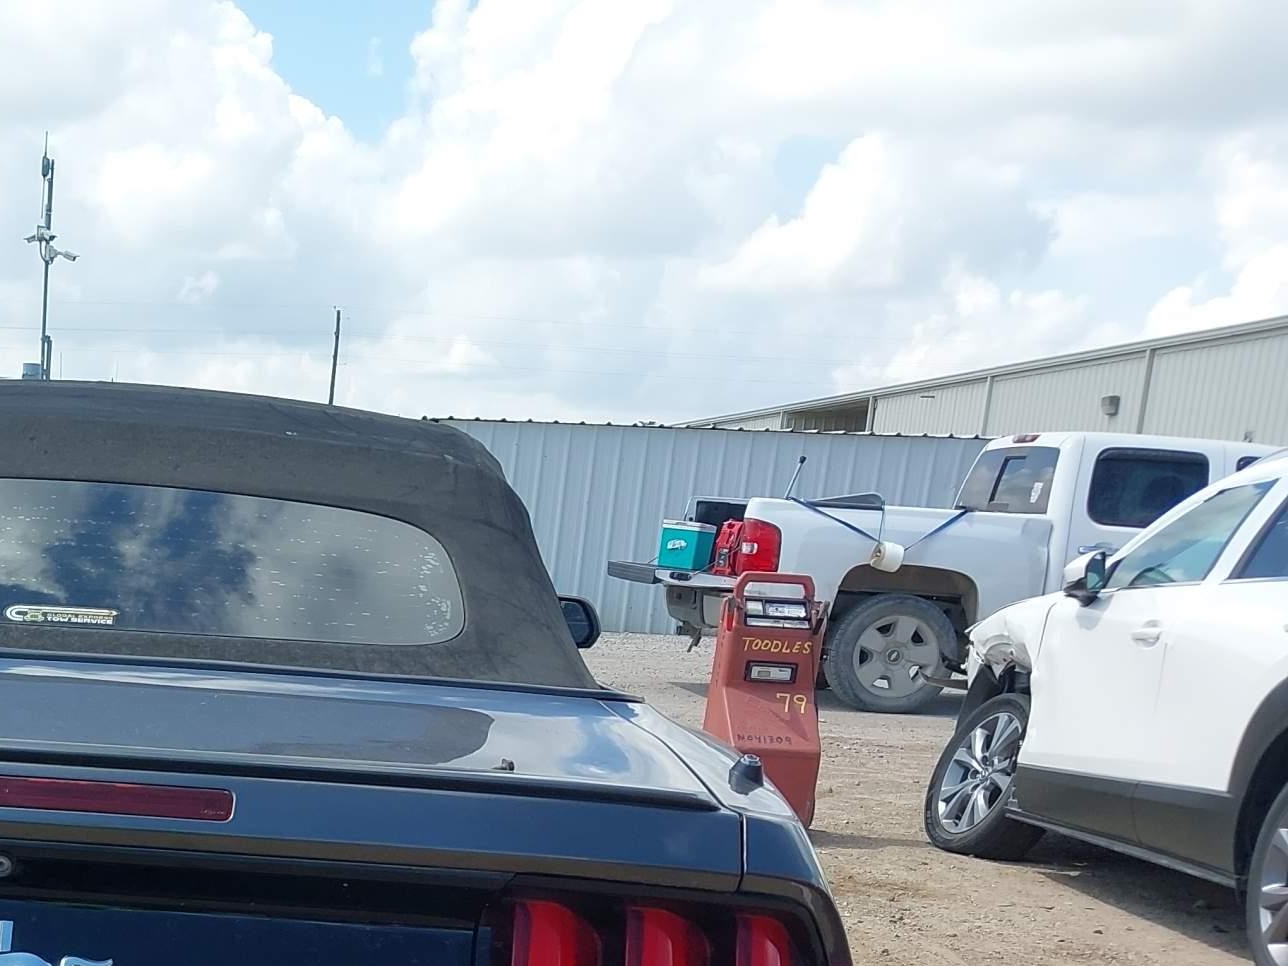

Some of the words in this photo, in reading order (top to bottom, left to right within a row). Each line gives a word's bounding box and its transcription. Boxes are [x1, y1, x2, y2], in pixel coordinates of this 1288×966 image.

[70, 617, 113, 625] SERVICE
[742, 637, 812, 654] TOODLES
[776, 692, 807, 714] 79
